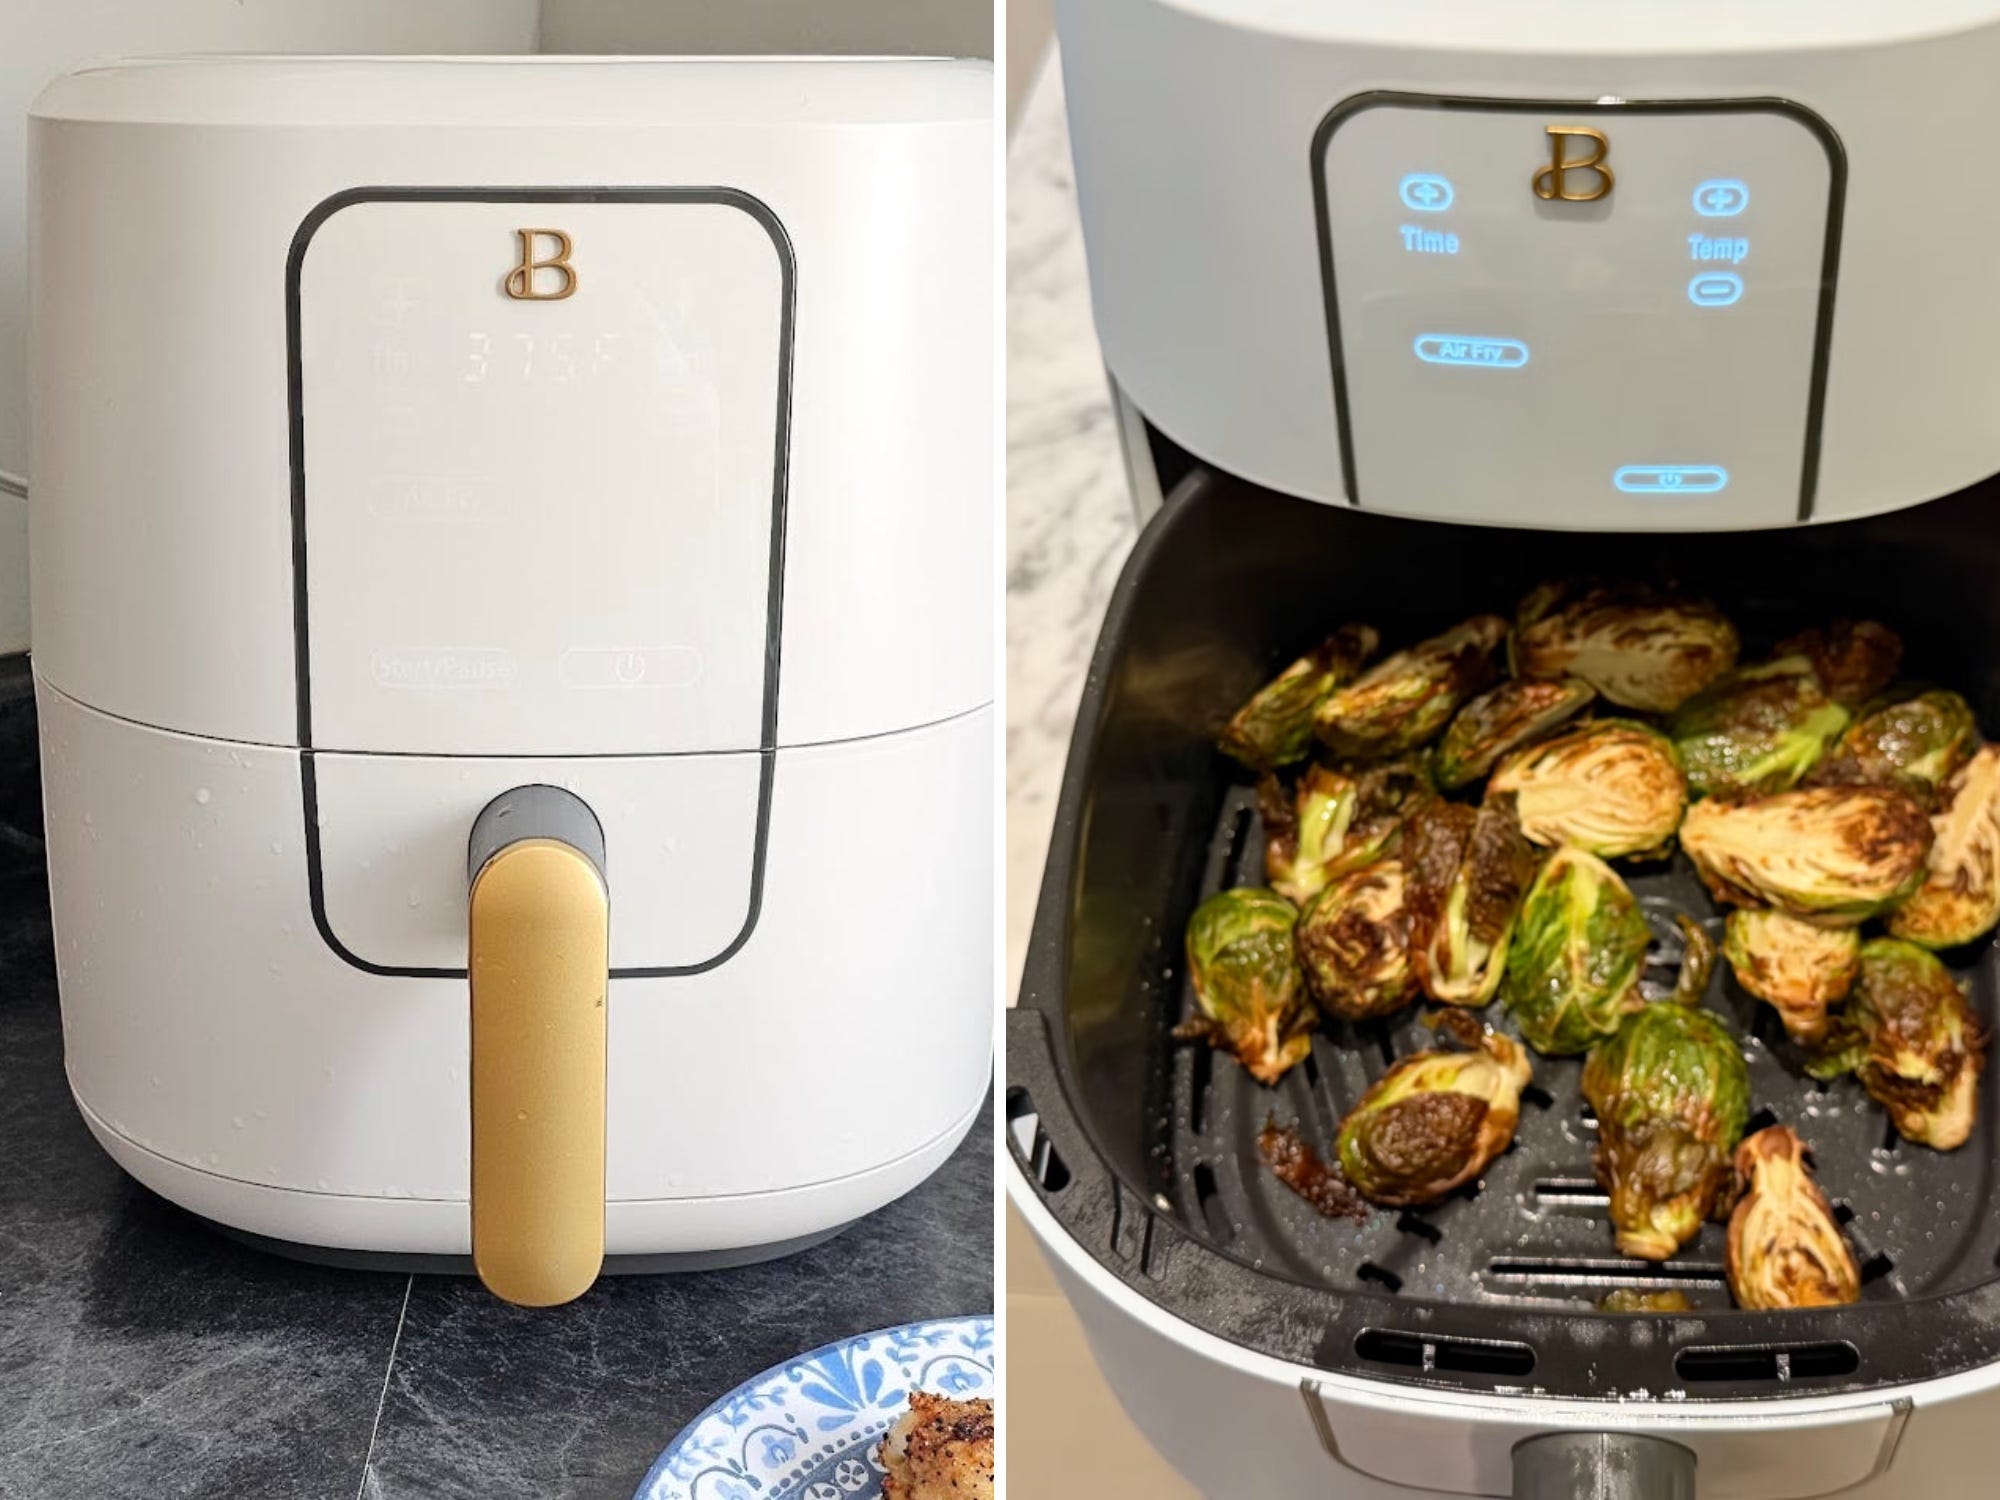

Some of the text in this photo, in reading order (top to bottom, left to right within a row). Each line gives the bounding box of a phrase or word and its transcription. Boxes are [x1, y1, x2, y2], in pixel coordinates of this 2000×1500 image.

[1532, 126, 1615, 201] B
[1401, 226, 1460, 255] Time
[1688, 234, 1749, 264] Temp
[504, 228, 578, 300] B
[1439, 342, 1502, 362] Air Fry
